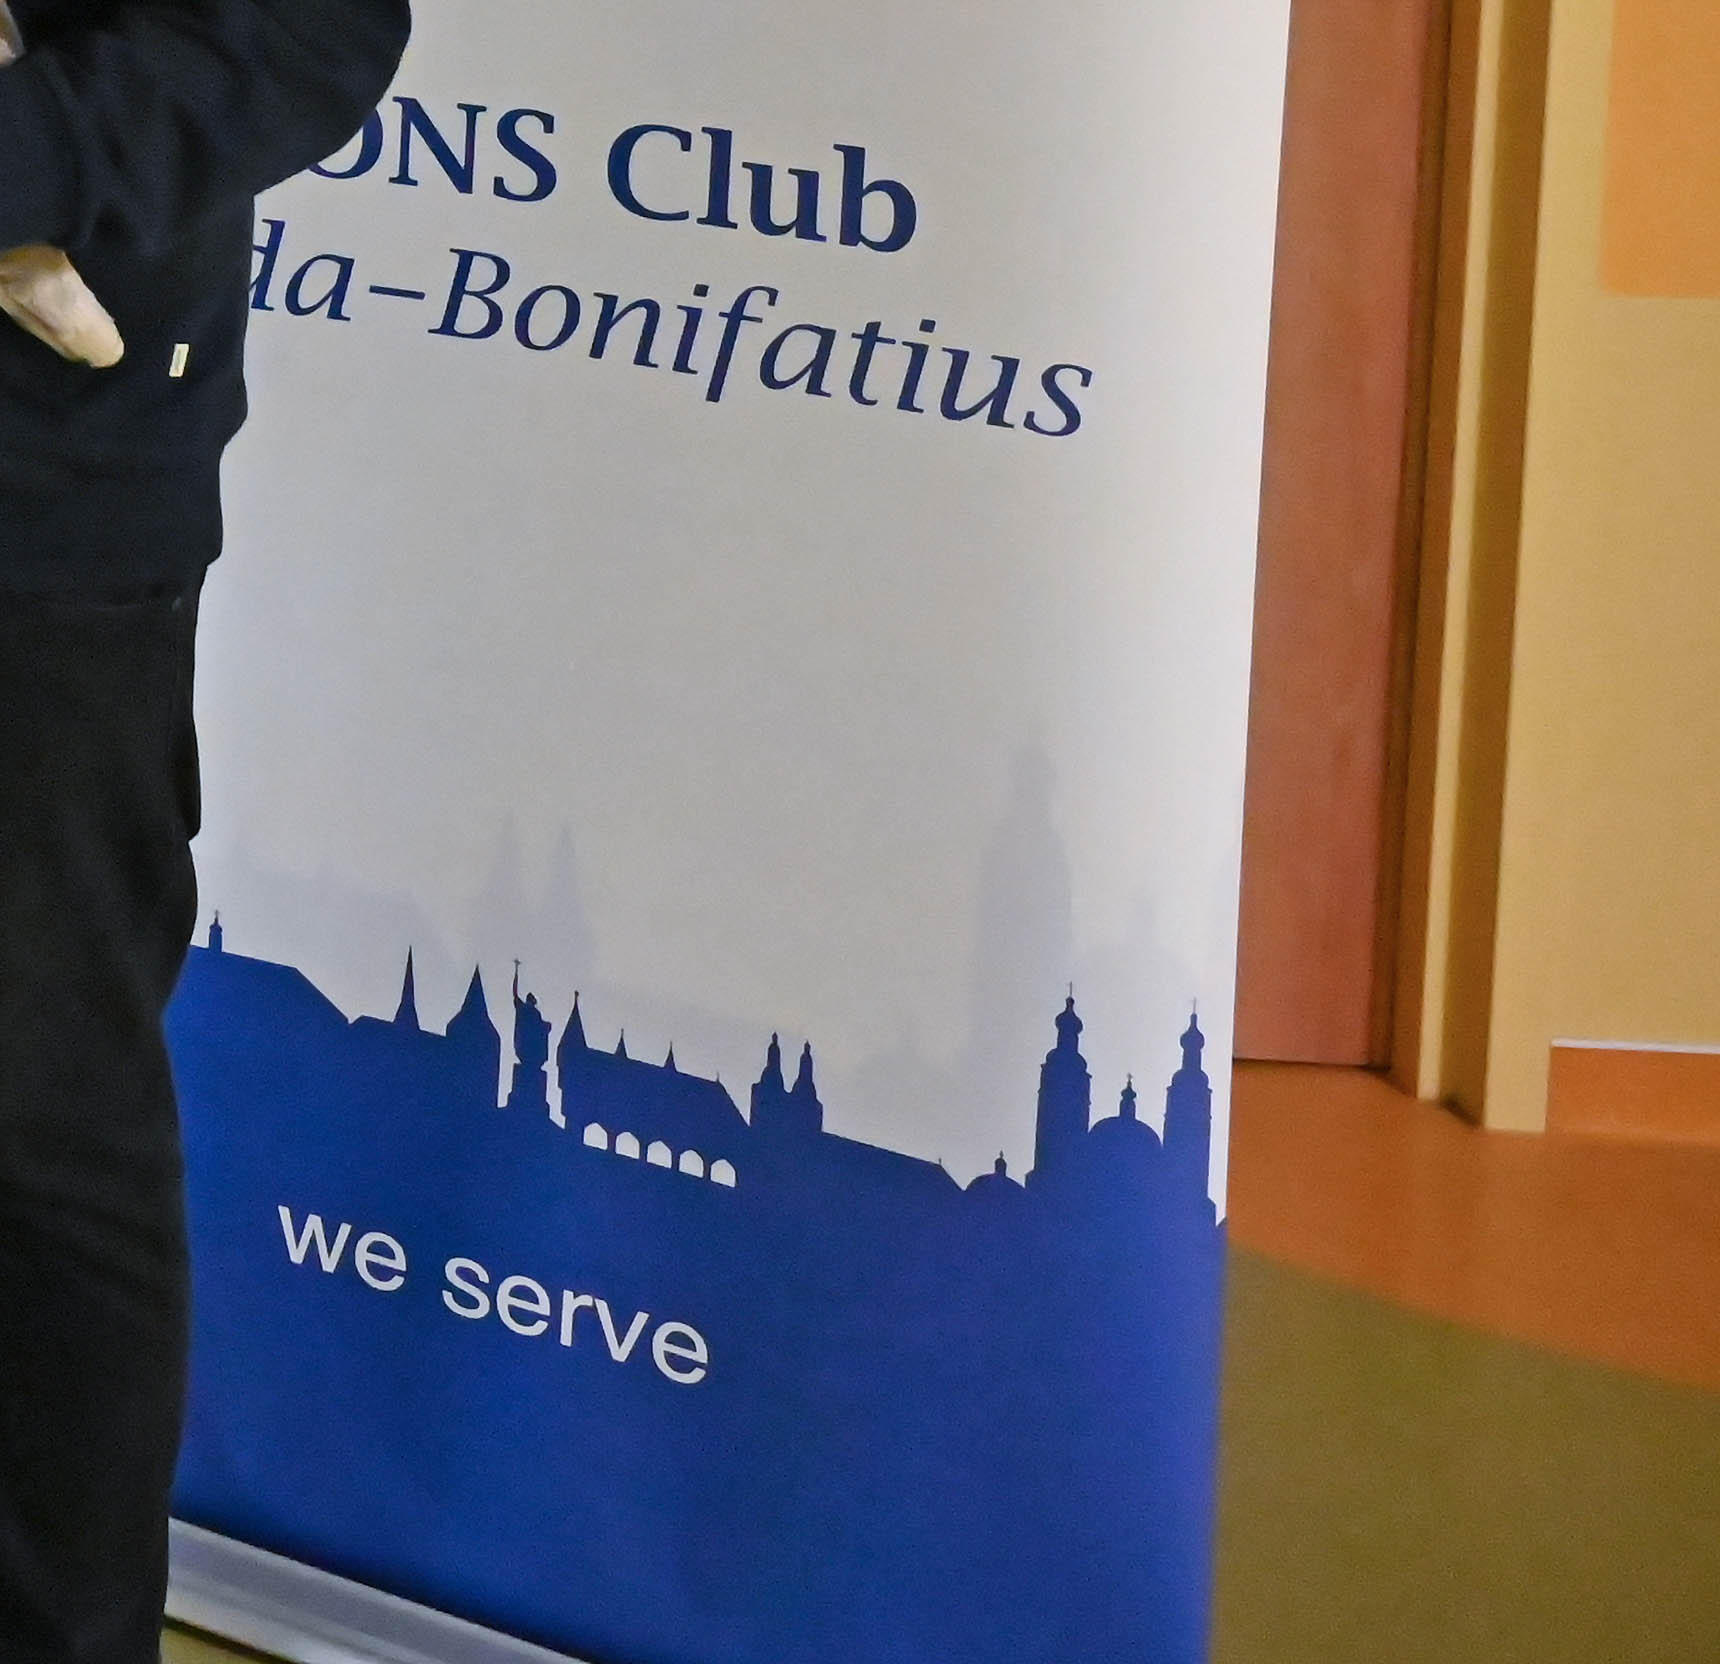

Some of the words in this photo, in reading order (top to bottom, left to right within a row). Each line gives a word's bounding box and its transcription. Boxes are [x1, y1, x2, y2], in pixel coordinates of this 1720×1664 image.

[605, 123, 919, 253] Club
[276, 1204, 408, 1292] we
[441, 1256, 709, 1386] serve
